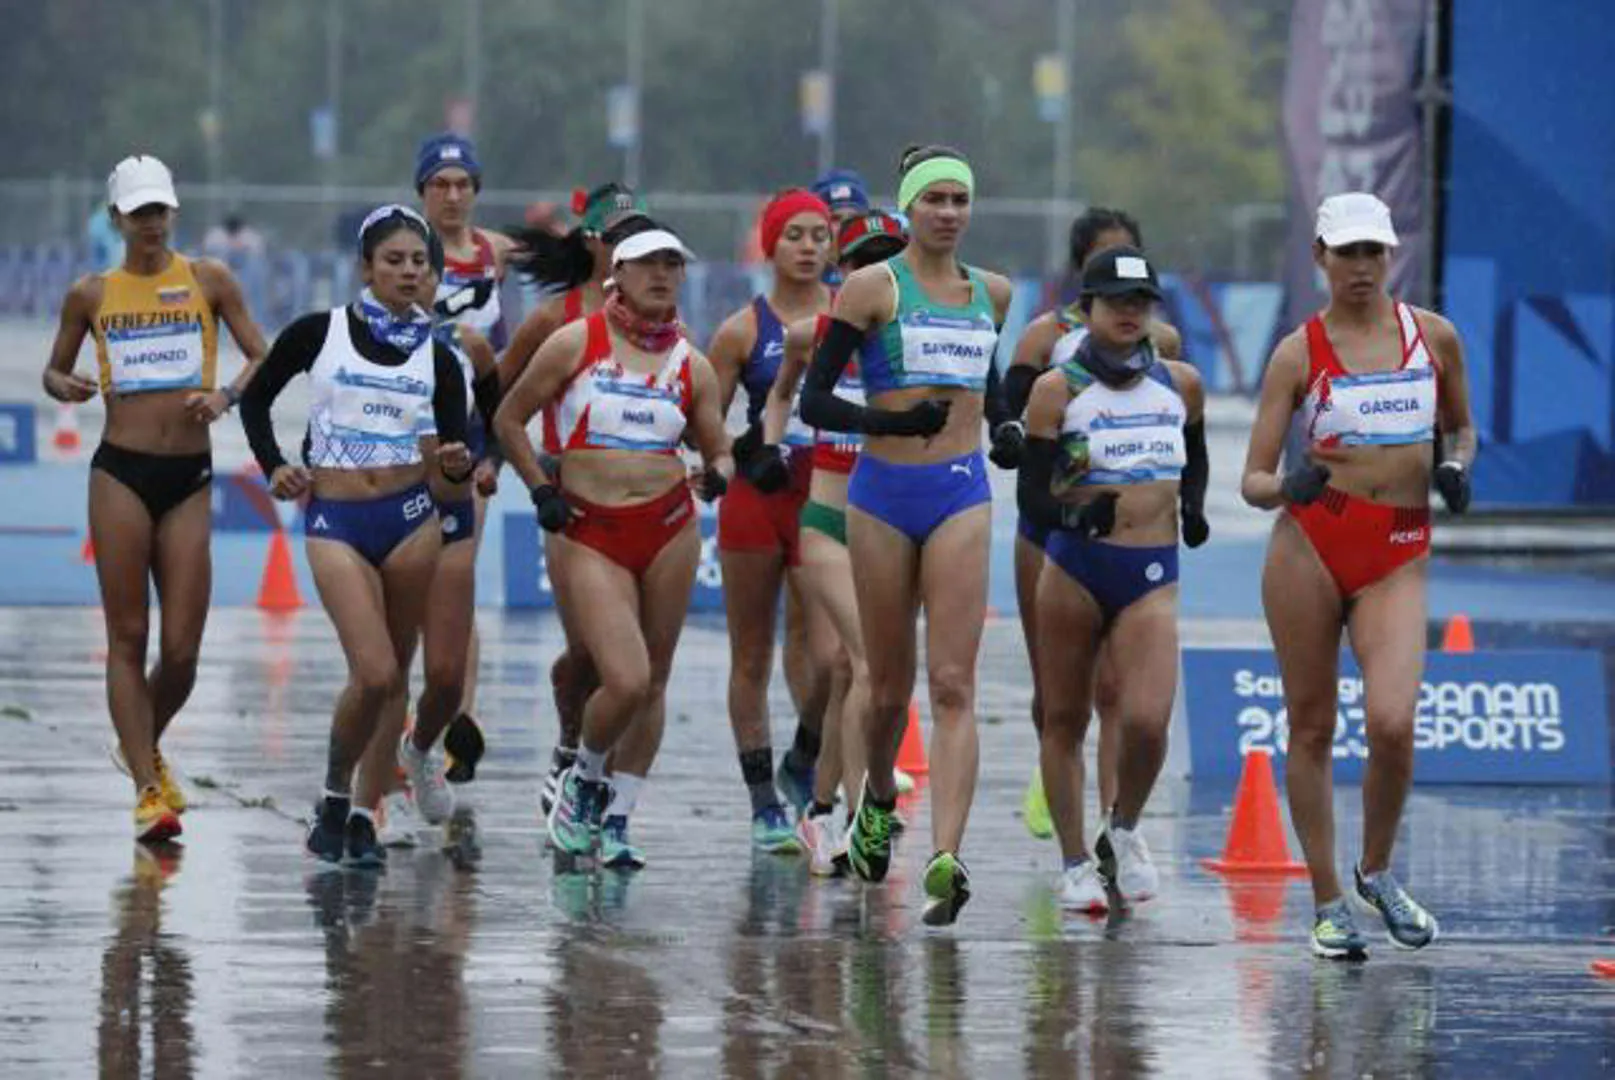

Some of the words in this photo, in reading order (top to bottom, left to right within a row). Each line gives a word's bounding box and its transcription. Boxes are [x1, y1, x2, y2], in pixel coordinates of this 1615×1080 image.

[922, 342, 984, 357] SANTANA
[362, 403, 404, 419] ORTIZ
[1359, 398, 1420, 415] GARCIA
[1416, 681, 1560, 716] PANAM
[1413, 715, 1566, 750] SPORTS
